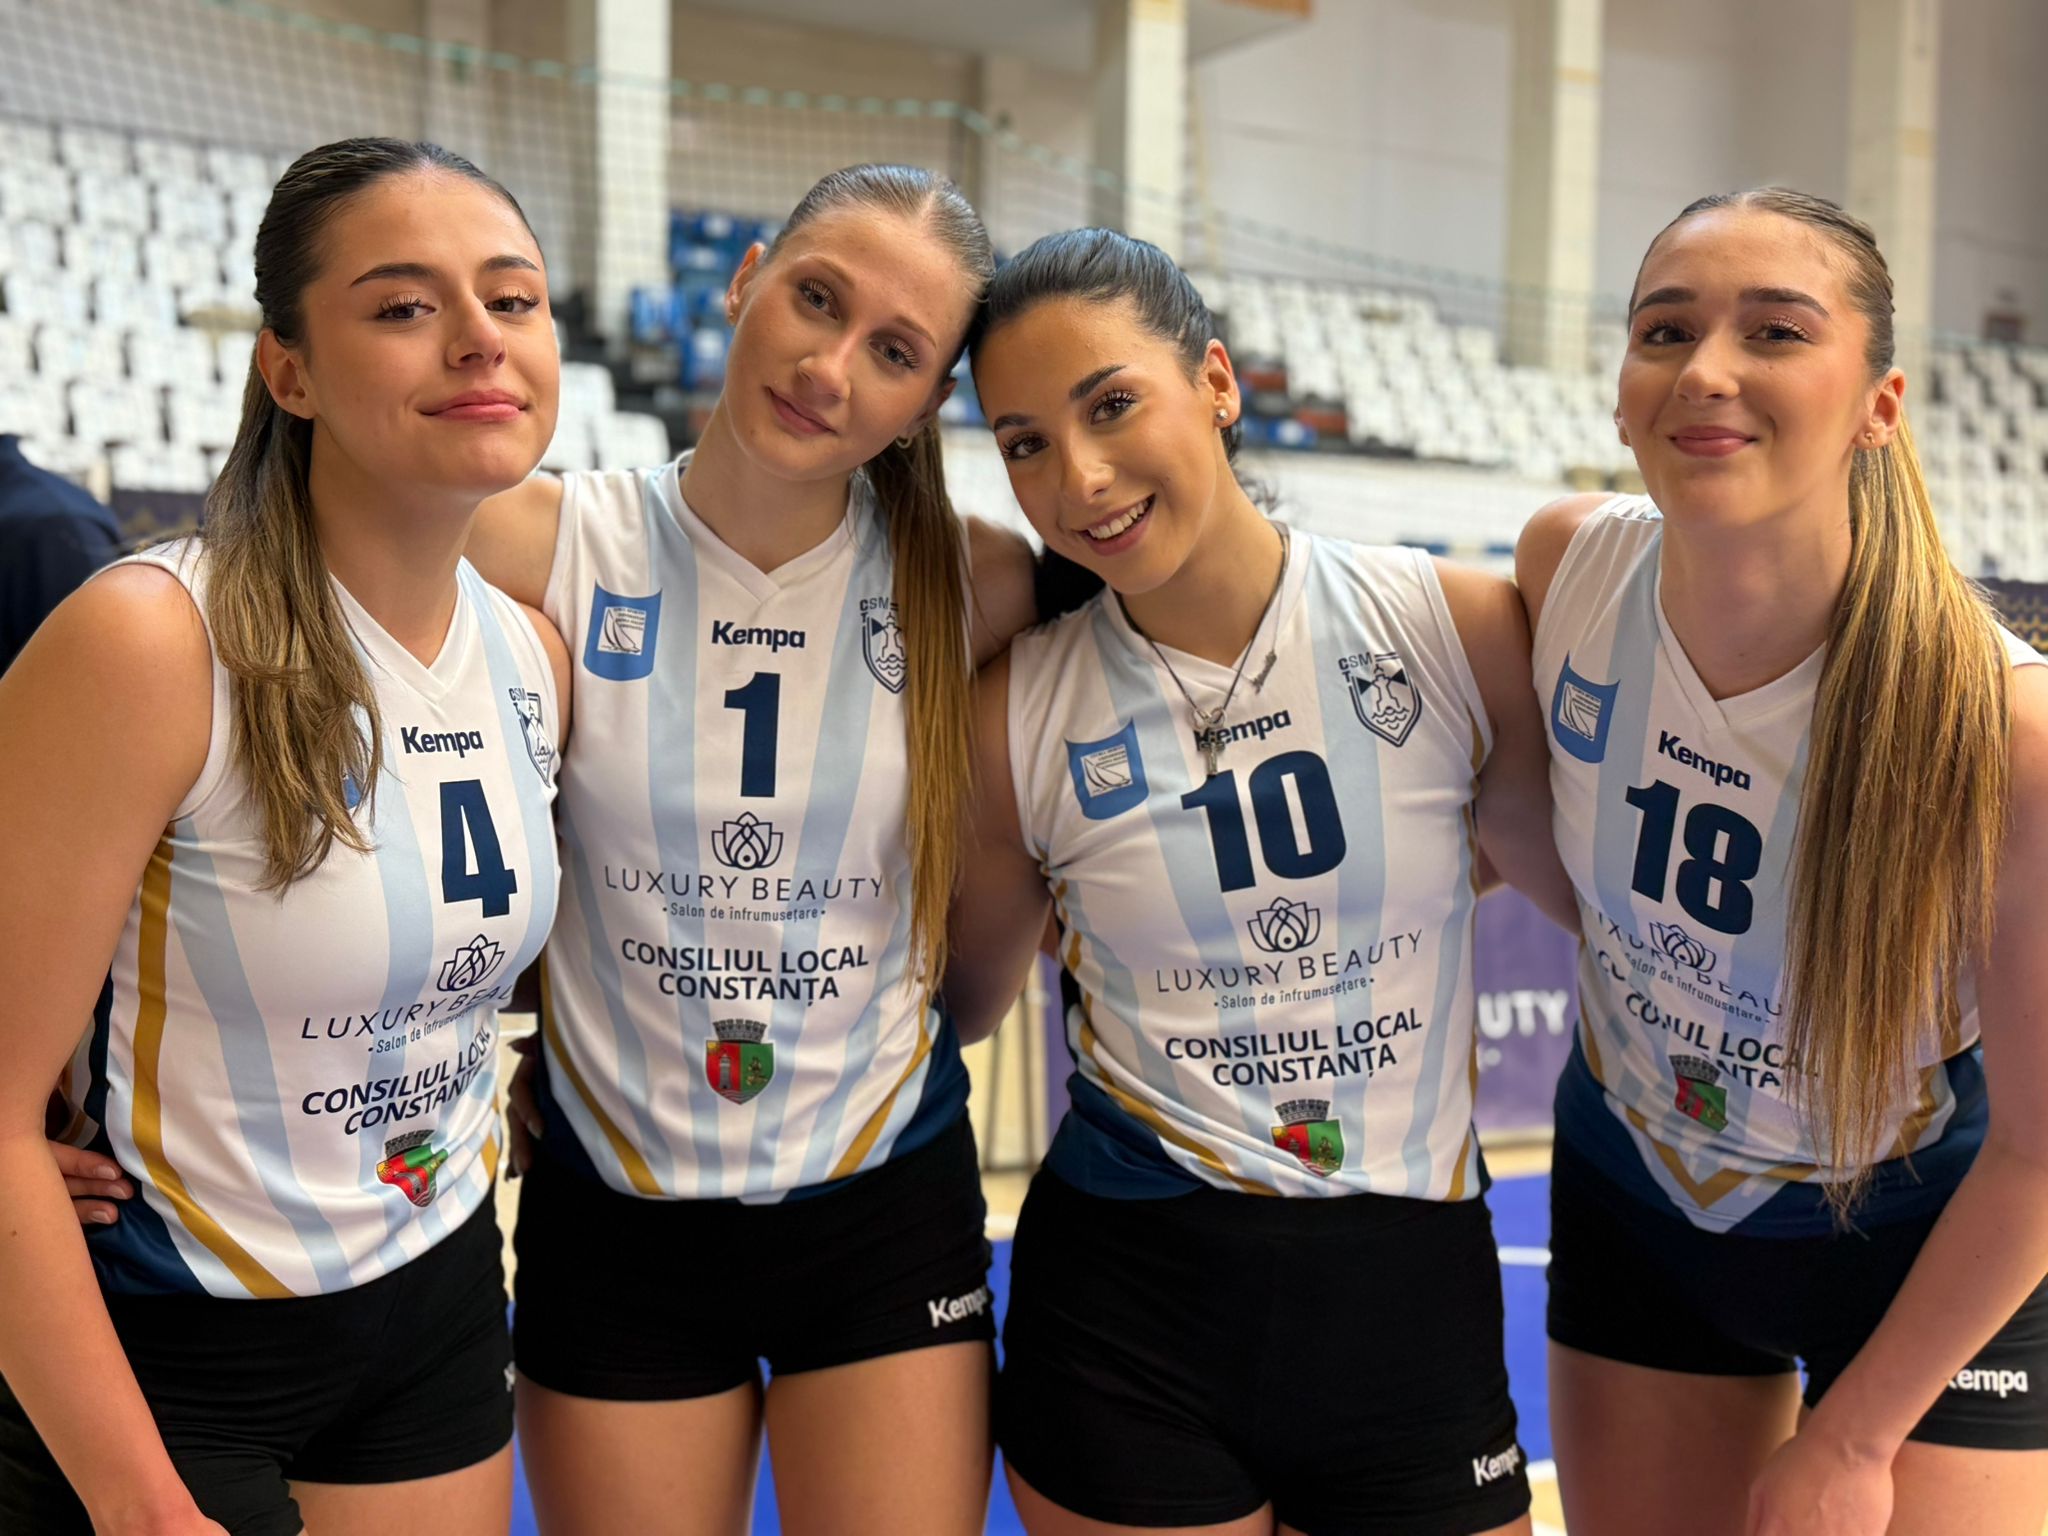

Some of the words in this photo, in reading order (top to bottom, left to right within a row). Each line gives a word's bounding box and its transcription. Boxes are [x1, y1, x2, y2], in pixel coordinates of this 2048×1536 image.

[860, 596, 889, 611] CSM
[711, 620, 806, 653] Kempa
[1338, 651, 1372, 670] CSM
[401, 726, 484, 758] Kempa
[724, 672, 781, 798] 1
[1657, 730, 1751, 791] Kempa
[1180, 750, 1347, 893] 10
[439, 779, 518, 919] 4
[1625, 779, 1762, 935] 18
[604, 865, 740, 899] LUXURY
[752, 872, 883, 902] BEAUTY
[670, 902, 705, 917] Salon
[710, 905, 725, 919] de
[621, 938, 772, 973] CONSILIUL
[781, 945, 869, 974] LOCAL
[1156, 959, 1284, 993] LUXURY
[1298, 928, 1423, 980] BEAUTY
[658, 972, 840, 1007] CONSTANȚA
[1660, 970, 1674, 984] de
[301, 998, 448, 1039] LUXURY
[1221, 995, 1256, 1009] Salon
[1260, 992, 1275, 1006] de
[376, 1034, 407, 1054] Salon
[410, 1027, 421, 1043] de
[1164, 1029, 1328, 1060] CONSILIUL
[1336, 1008, 1422, 1048] LOCAL
[1212, 1043, 1398, 1087] CONSTANȚA
[302, 1060, 450, 1115] CONSILIUL
[1948, 1369, 2028, 1398] empa
